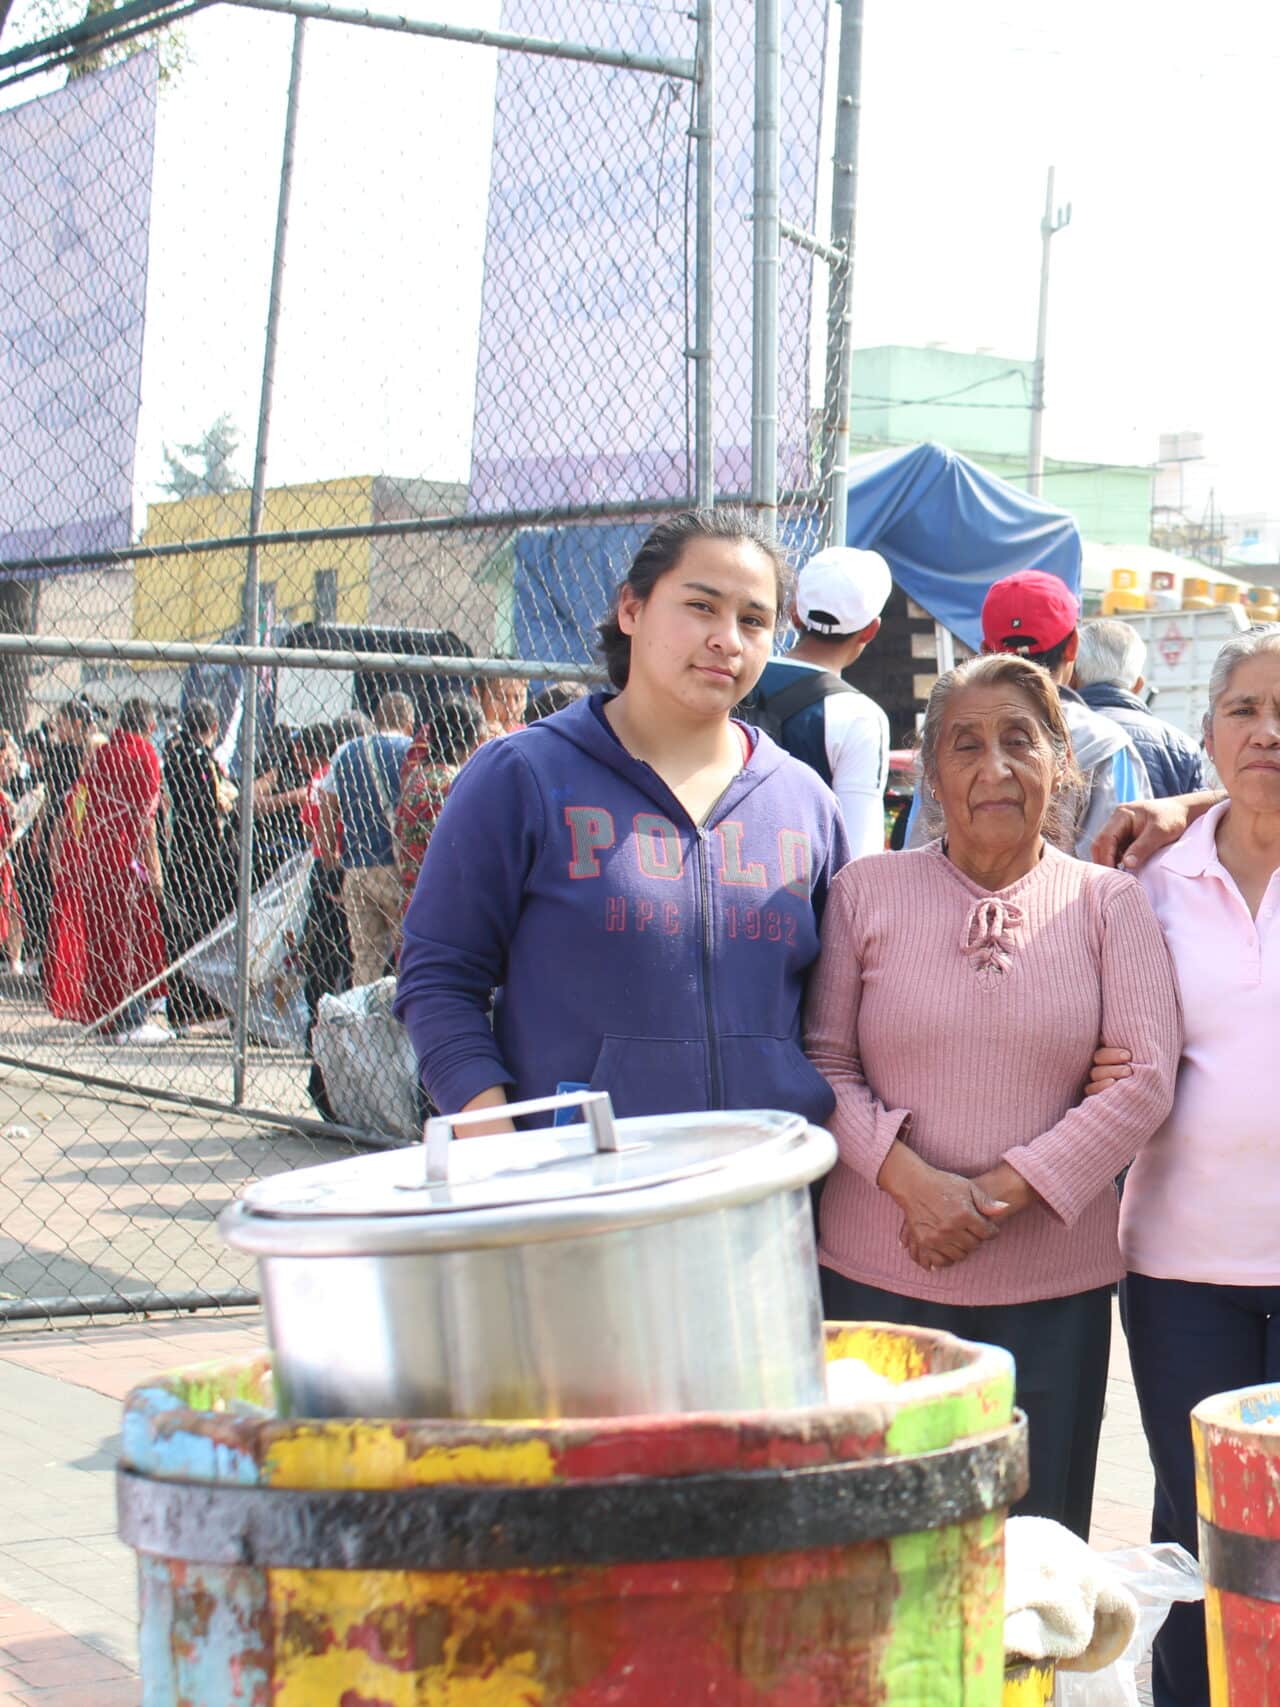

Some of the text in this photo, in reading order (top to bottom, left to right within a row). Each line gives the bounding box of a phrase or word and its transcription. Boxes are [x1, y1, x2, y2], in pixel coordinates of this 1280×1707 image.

[564, 806, 811, 901] POLO
[606, 896, 800, 947] HPC 1982
